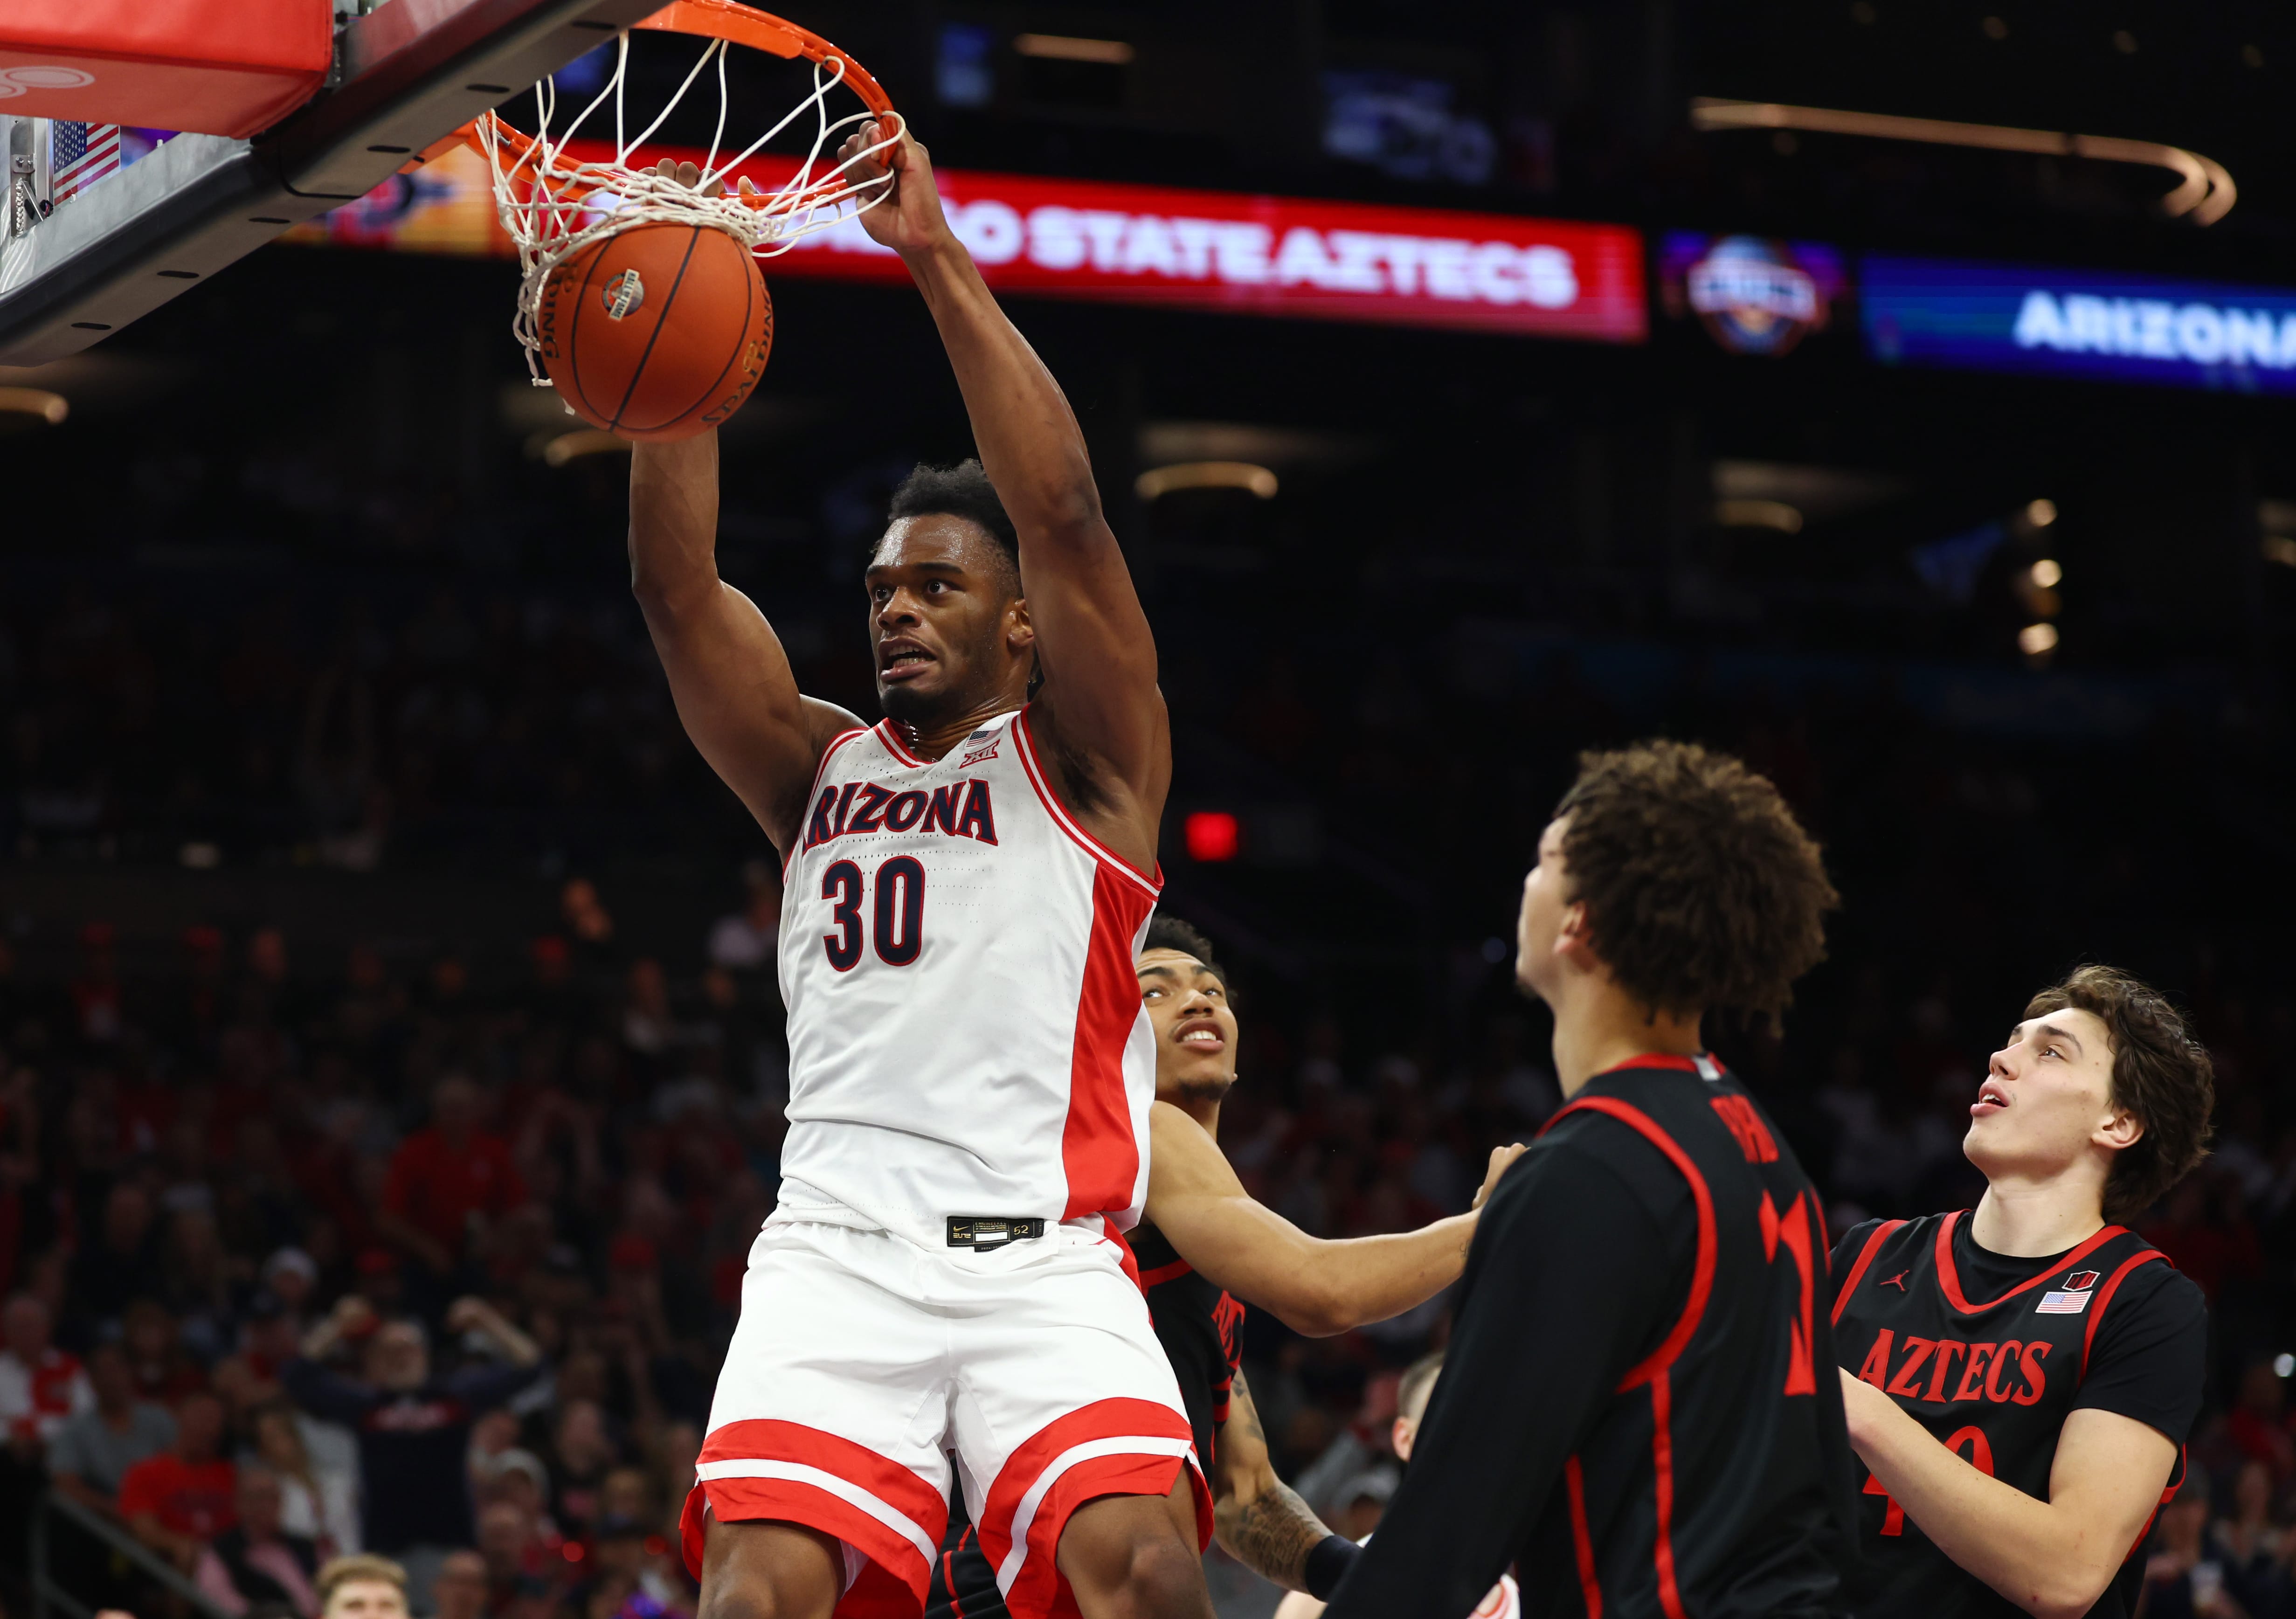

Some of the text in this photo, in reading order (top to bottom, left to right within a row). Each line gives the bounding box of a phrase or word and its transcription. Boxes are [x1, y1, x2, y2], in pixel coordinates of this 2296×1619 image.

[1028, 207, 1273, 284] STATE
[1274, 227, 1575, 308] AZTECS
[802, 779, 998, 857] RIZONA
[822, 855, 926, 972] 30
[1014, 1225, 1029, 1235] 52
[1858, 1328, 2053, 1406] AZTECS
